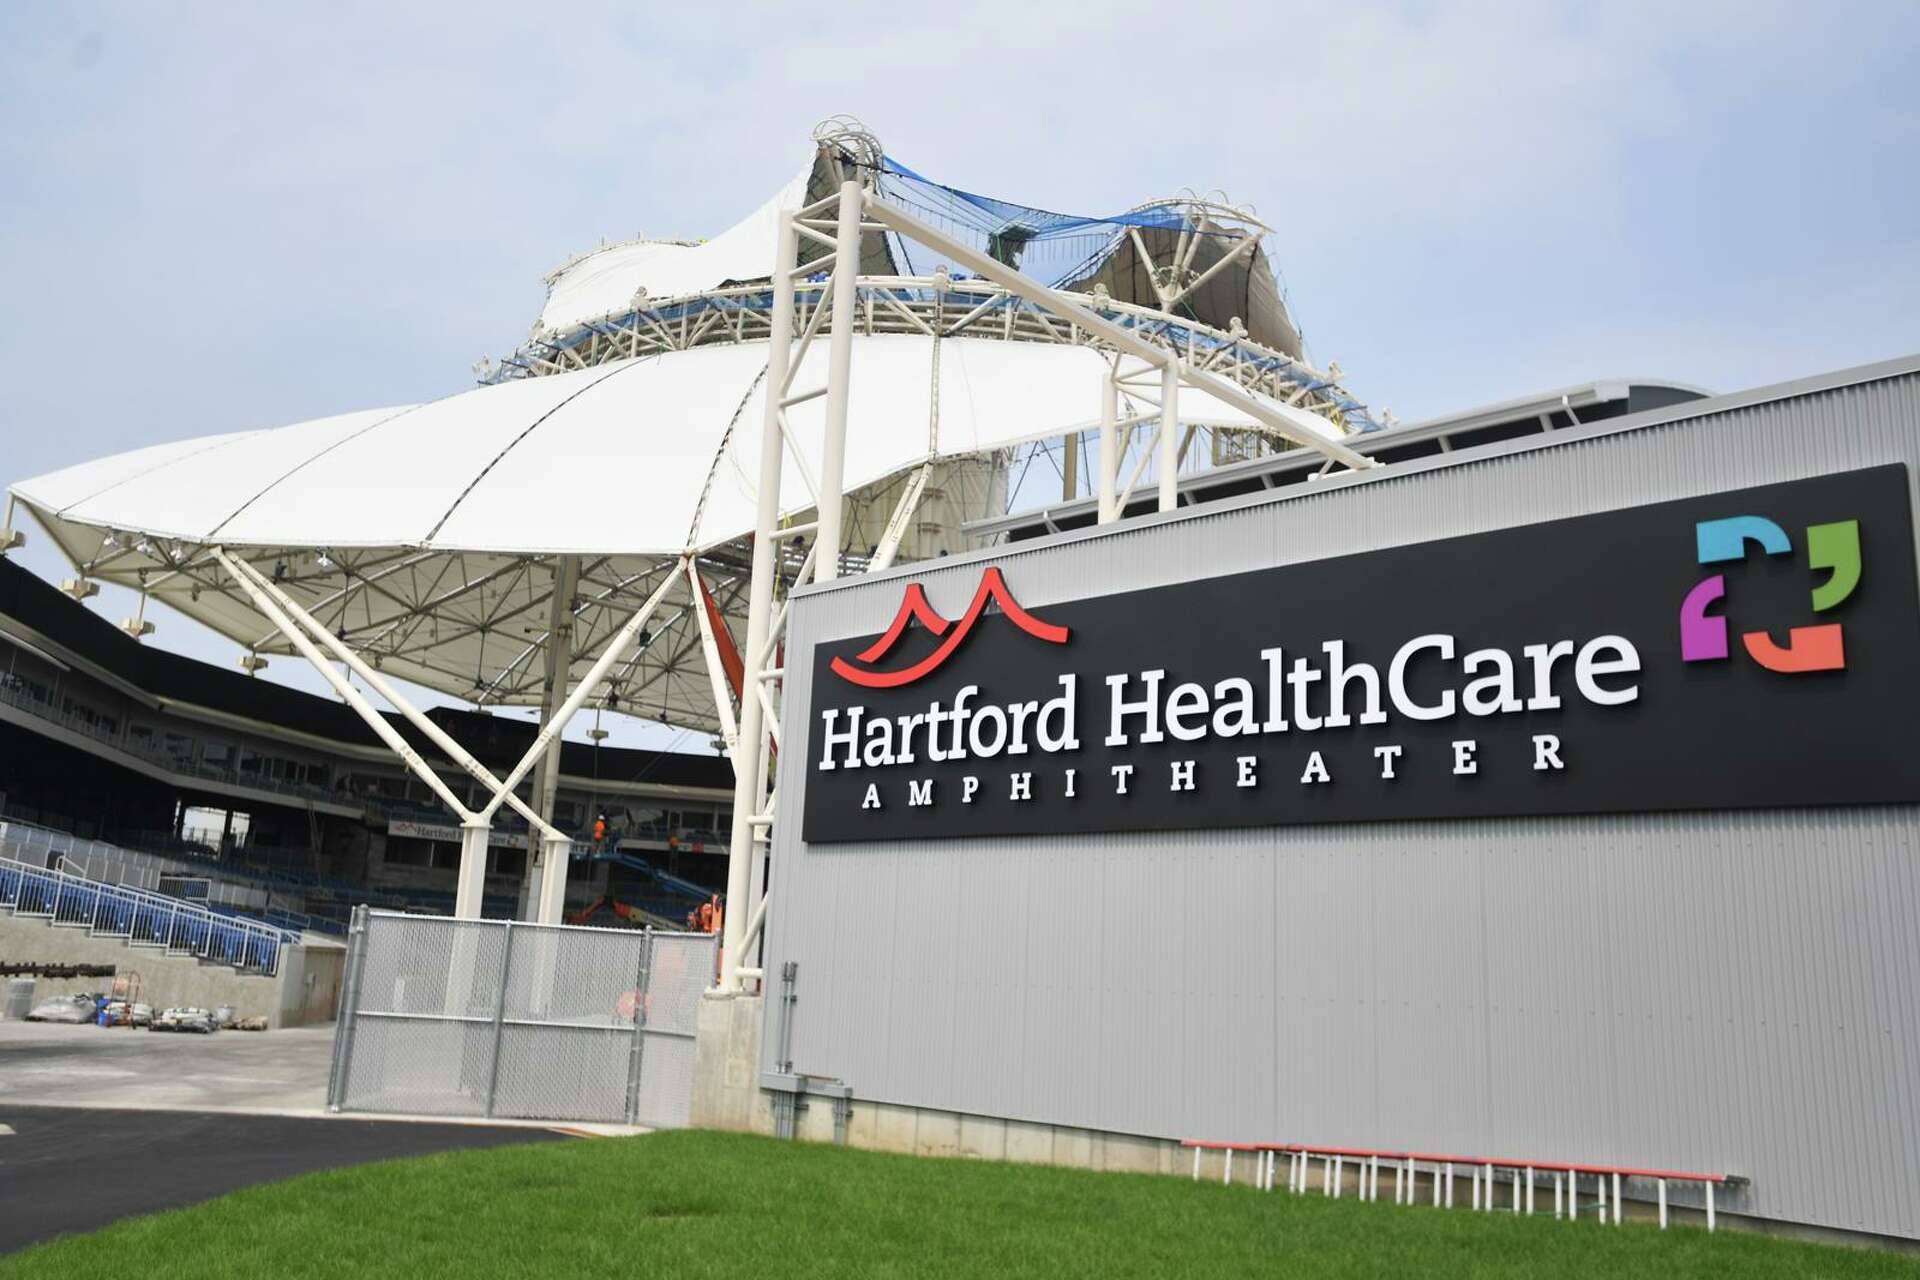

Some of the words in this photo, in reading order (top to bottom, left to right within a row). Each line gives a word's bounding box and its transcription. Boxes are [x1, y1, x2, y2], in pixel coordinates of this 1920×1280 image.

[819, 673, 1080, 771] Hartford
[1105, 634, 1641, 747] HealthCare
[861, 734, 1565, 809] AMPHITHEATER
[417, 826, 456, 841] Hartford
